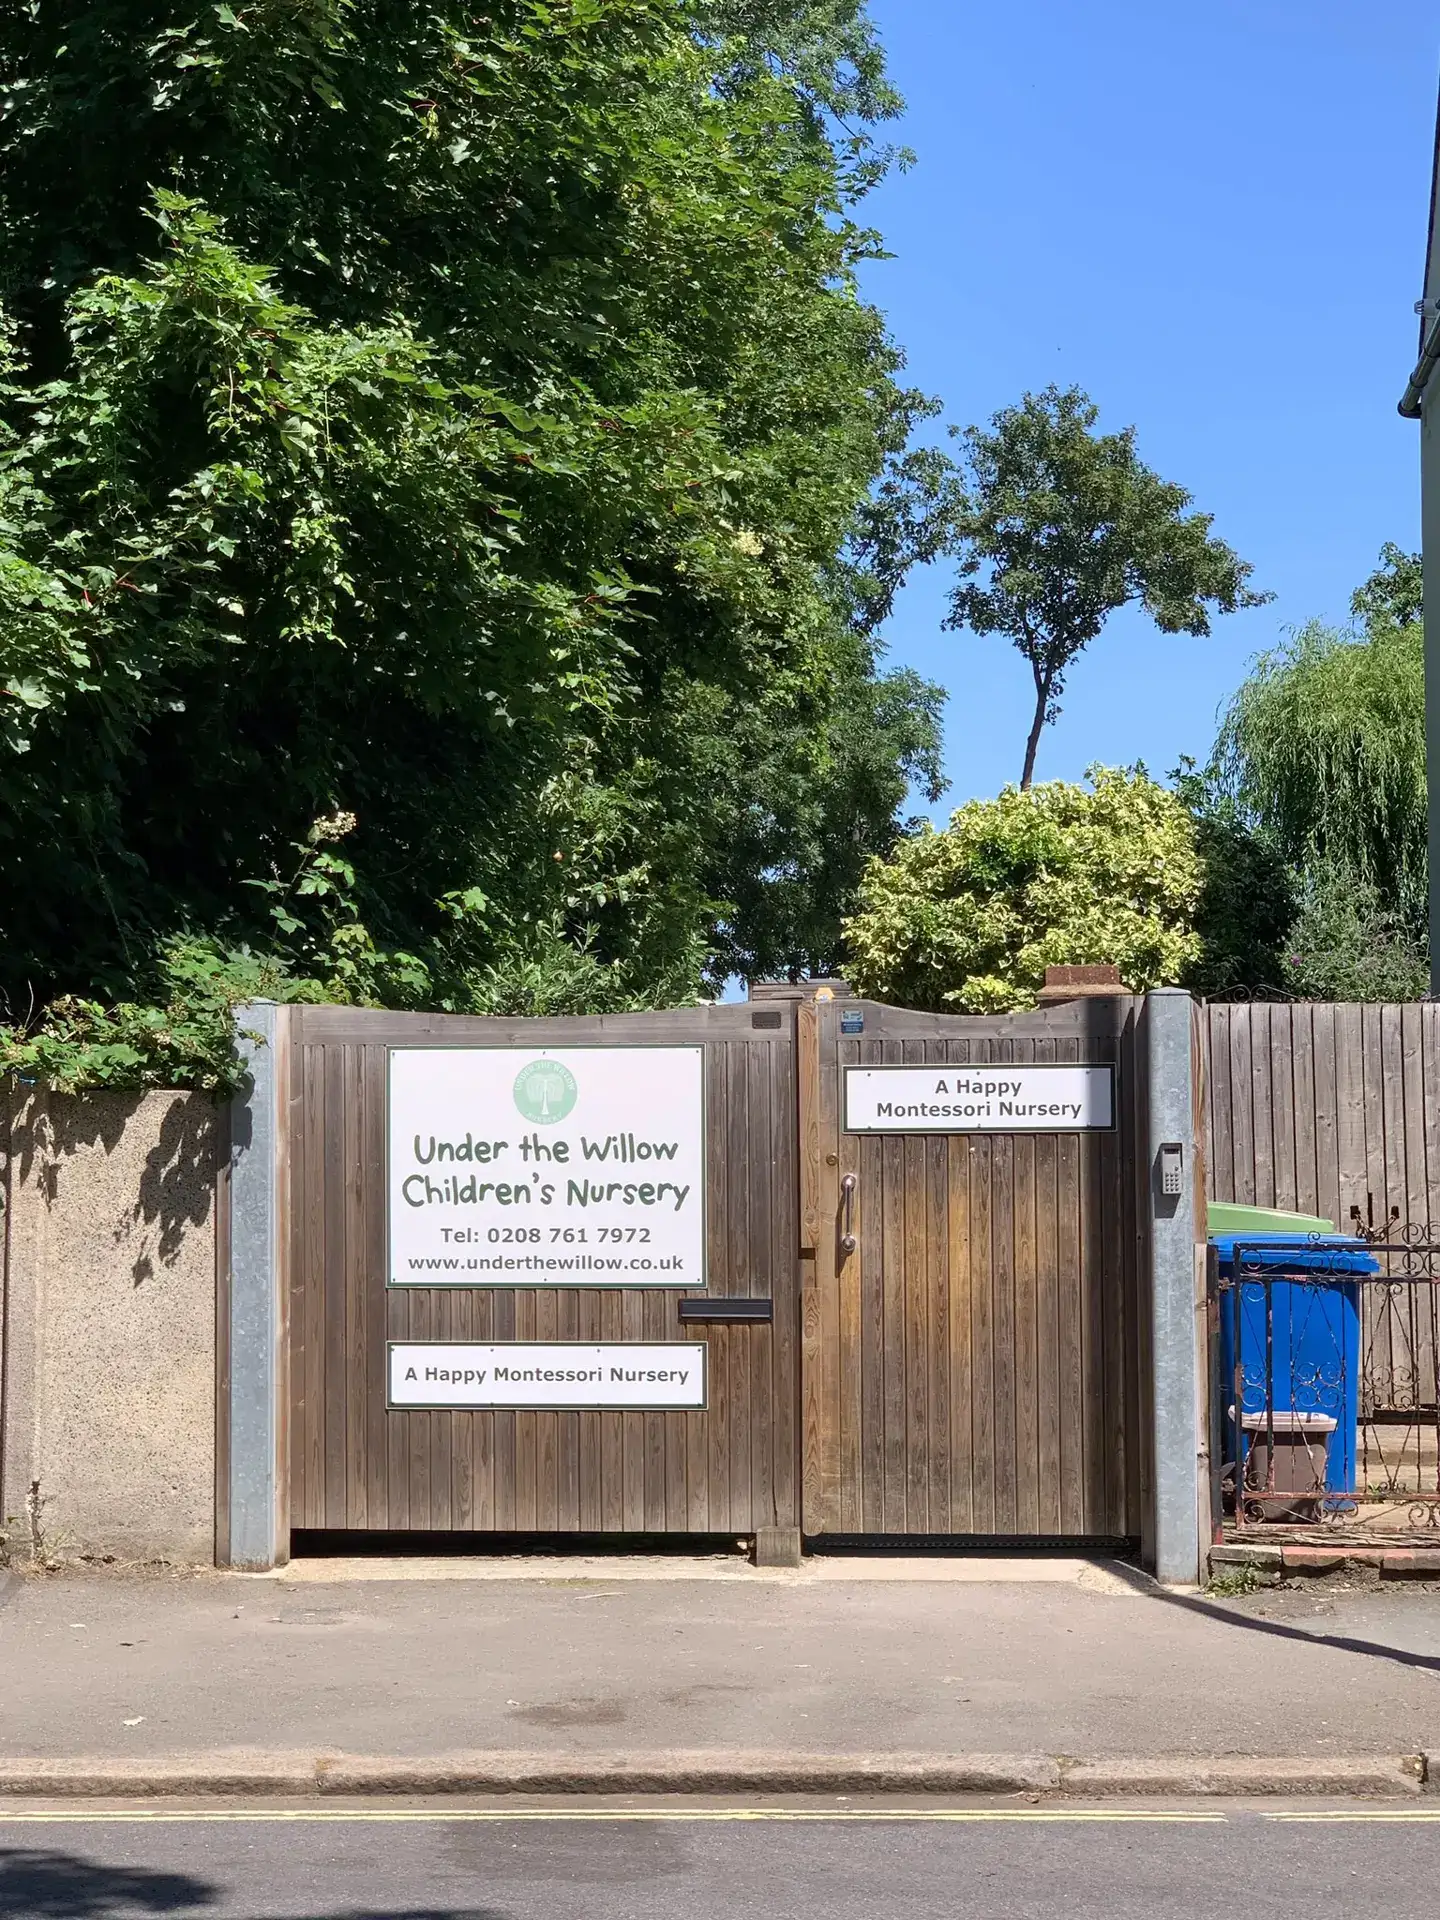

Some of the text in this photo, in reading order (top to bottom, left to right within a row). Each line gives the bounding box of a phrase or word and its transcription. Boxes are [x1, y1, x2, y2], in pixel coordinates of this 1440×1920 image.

[934, 1079, 1022, 1098] A Happy
[876, 1101, 1083, 1120] Montessori Nursery
[414, 1132, 679, 1165] Under the Willow
[402, 1172, 691, 1212] Children's Nursery
[440, 1227, 651, 1244] Tel: 0208 761 7972
[408, 1255, 684, 1270] www.underthewillow.co.uk
[404, 1367, 689, 1386] A Happy Montessori Nursery
